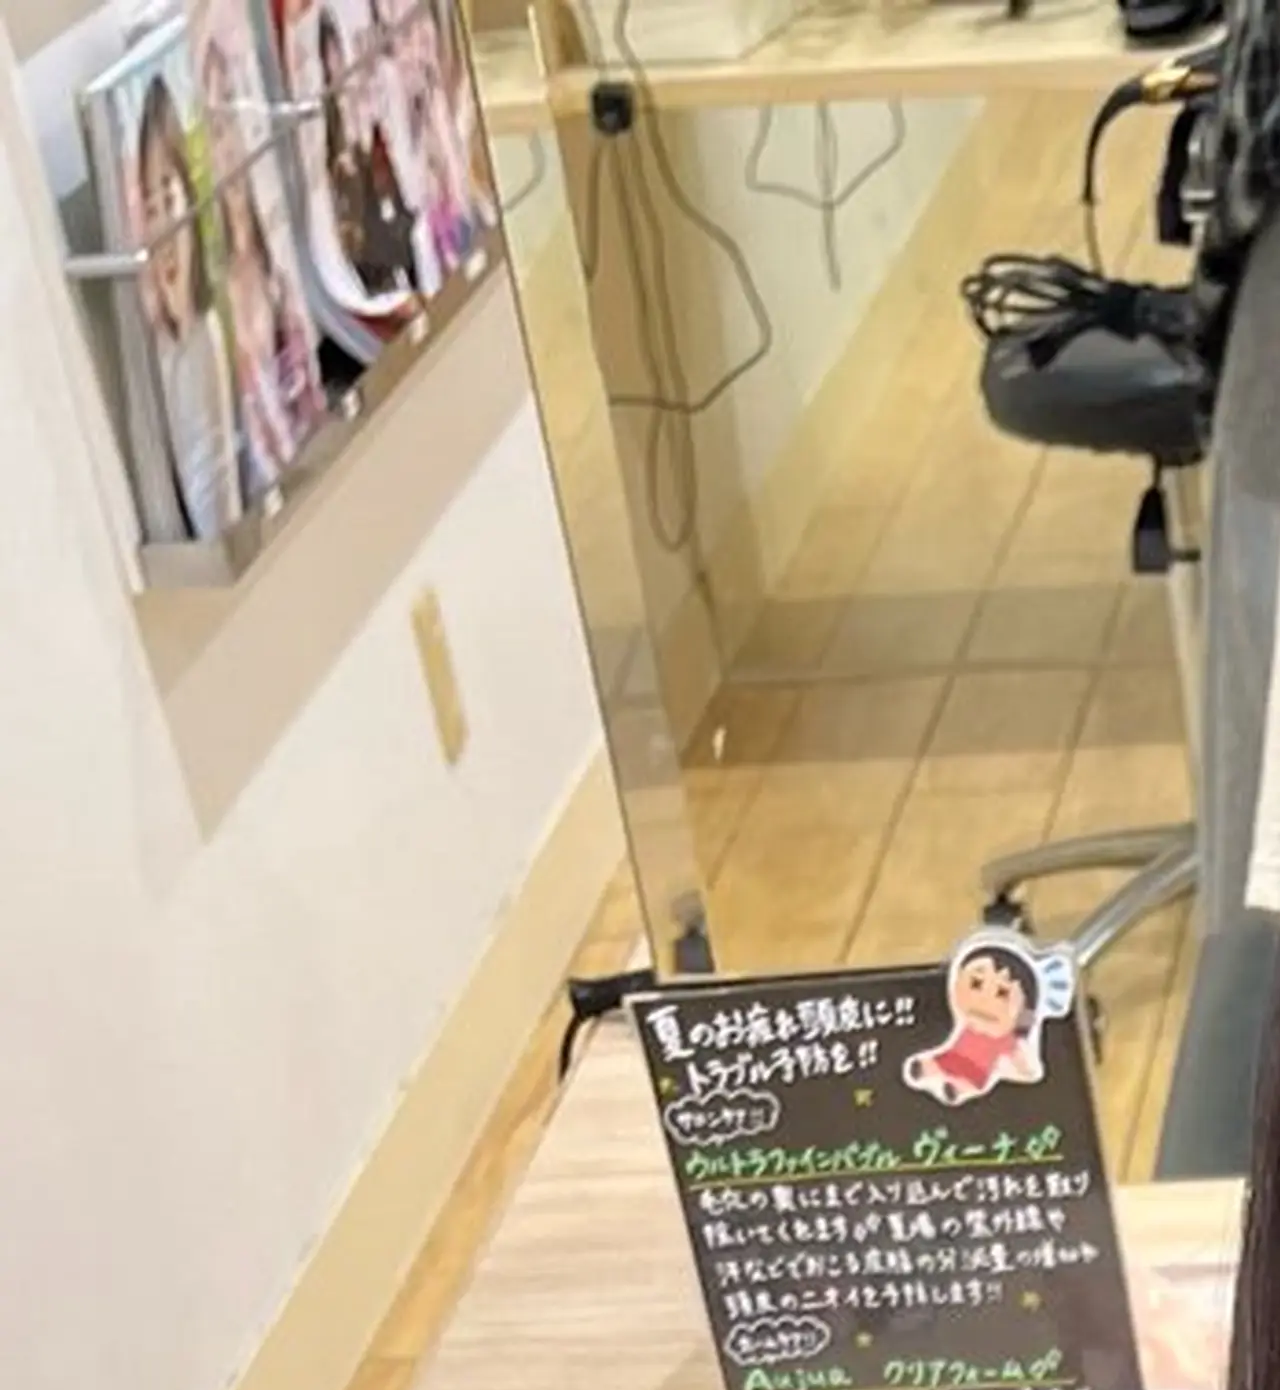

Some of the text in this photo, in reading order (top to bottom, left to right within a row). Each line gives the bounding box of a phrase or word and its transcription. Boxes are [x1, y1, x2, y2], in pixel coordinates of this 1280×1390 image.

[685, 1139, 900, 1180] ウルトラファインバブル
